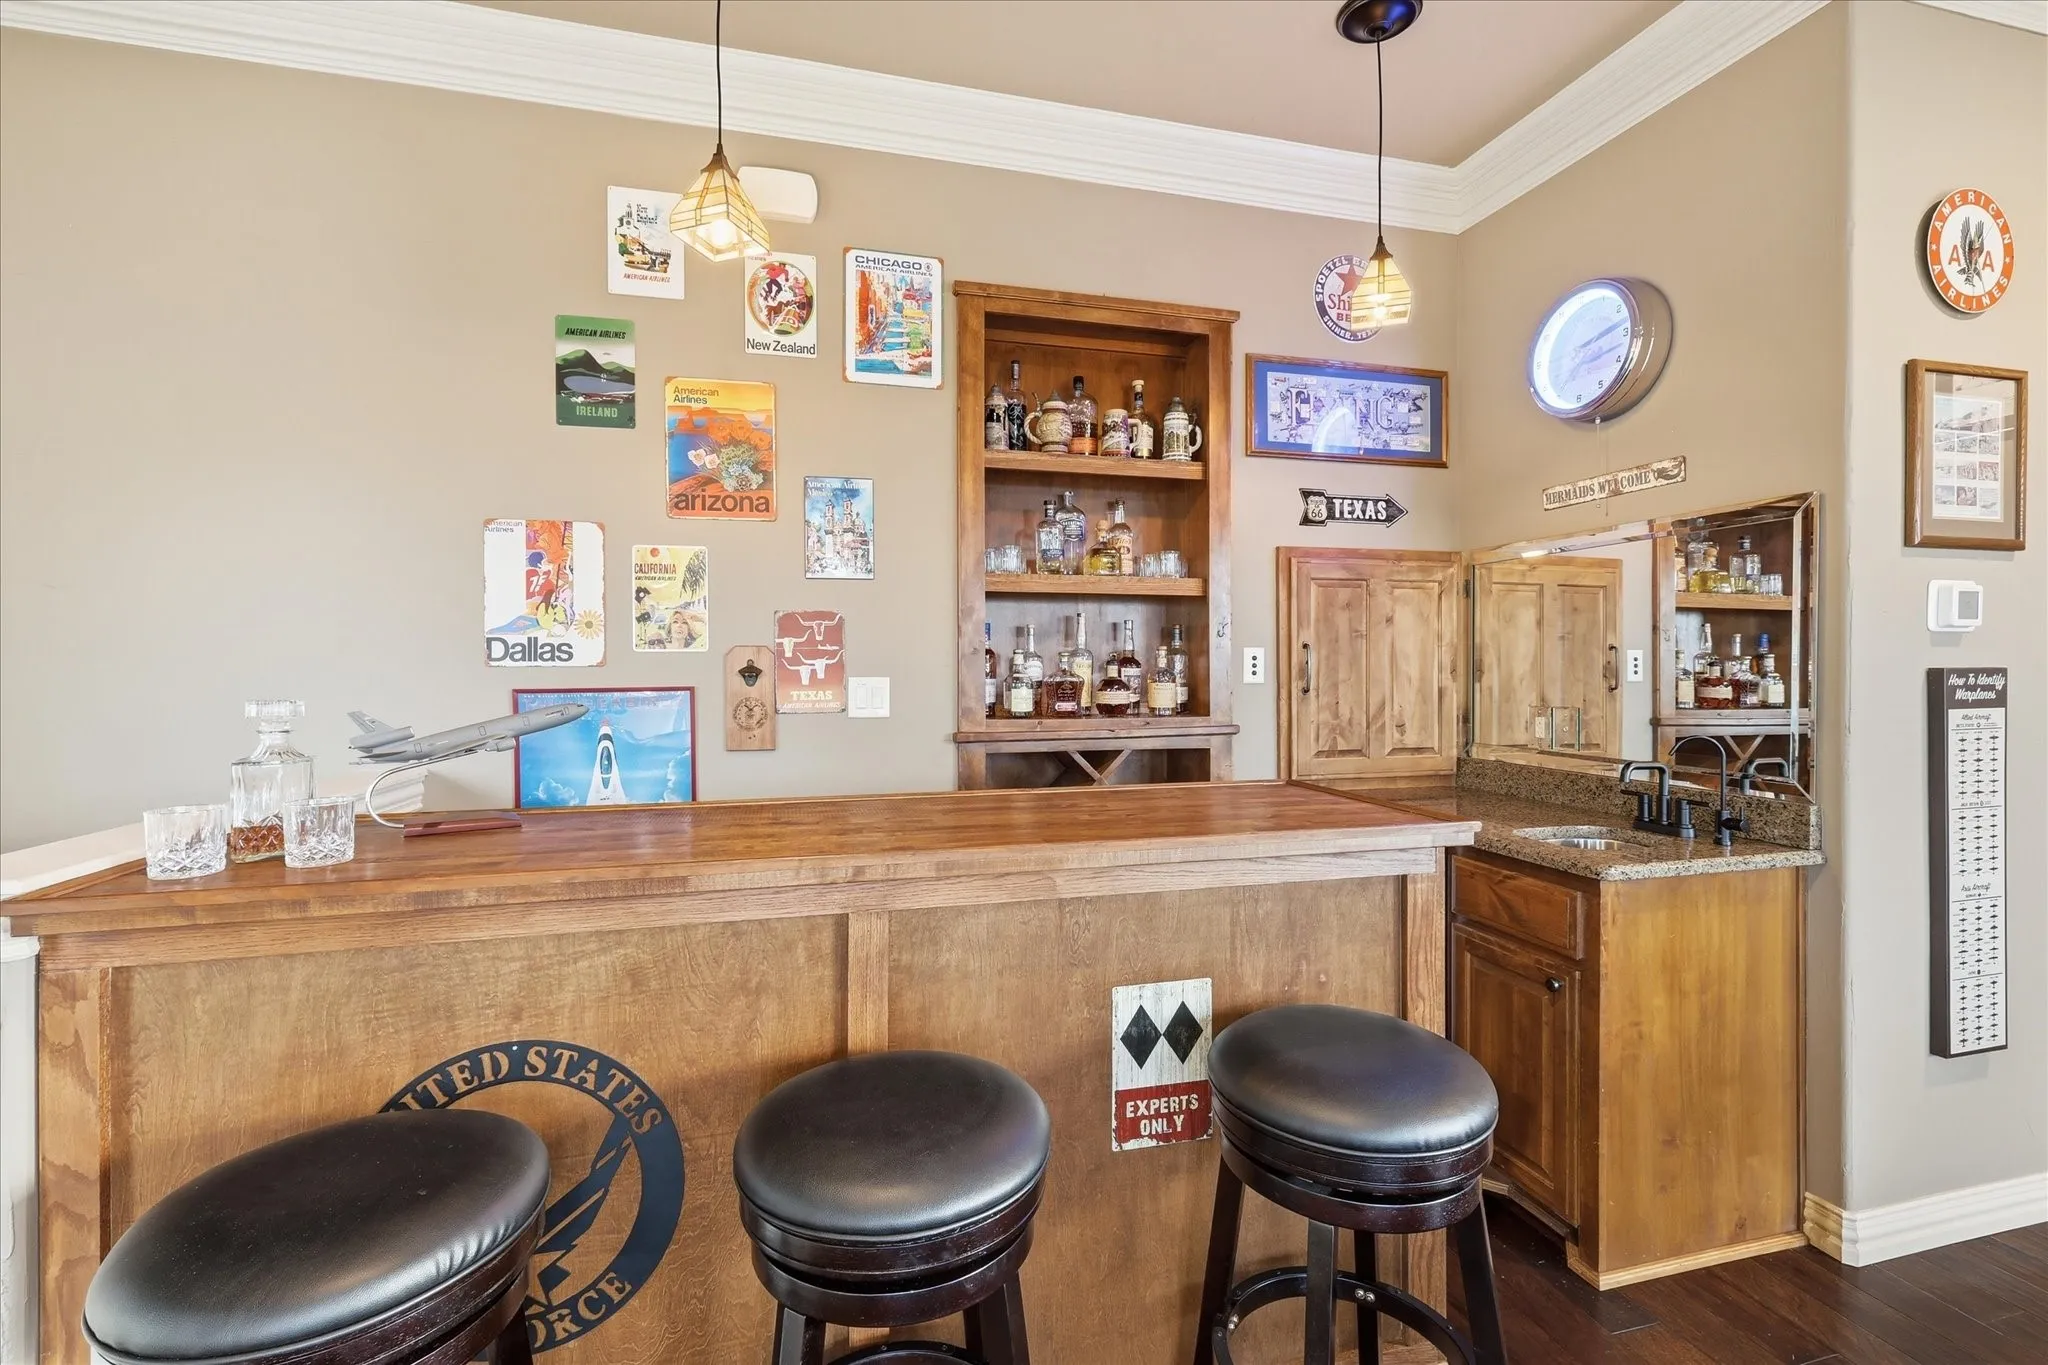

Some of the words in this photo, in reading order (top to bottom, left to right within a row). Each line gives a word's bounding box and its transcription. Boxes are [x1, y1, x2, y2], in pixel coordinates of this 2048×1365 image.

[1934, 191, 2011, 244] AMERICAN
[855, 255, 922, 270] CHICAGO
[1948, 244, 1961, 267] A
[1982, 250, 1994, 272] A
[856, 264, 897, 273] AMERICAN
[900, 269, 933, 277] AIRLINES
[1315, 256, 1349, 302] SPOETZL
[1932, 264, 2008, 309] AIRLINES
[1327, 293, 1351, 311] Shi
[1336, 312, 1351, 322] BE
[565, 327, 598, 337] AMERICAN
[599, 330, 626, 339] AIRLINES
[1622, 327, 1629, 337] 3
[746, 338, 772, 351] New
[773, 340, 816, 355] Zealand
[1615, 355, 1622, 363] 4
[673, 386, 719, 397] American
[1598, 380, 1604, 389] 5
[673, 394, 708, 404] Airlines
[576, 405, 618, 418] IRELAND
[674, 488, 770, 513] arizona
[1544, 483, 1595, 506] MERMAIDS
[1311, 508, 1323, 518] 66
[1332, 498, 1387, 520] TEXAS
[634, 563, 677, 574] CALIFORNIA
[486, 636, 574, 663] Dallas
[1948, 673, 1966, 686] How
[1967, 673, 1976, 685] To
[1976, 673, 2006, 690] Identify
[790, 690, 833, 701] TEXAS
[1955, 688, 1997, 703] Warplanes
[389, 1050, 510, 1111] ITED
[523, 1045, 663, 1134] STATES
[1126, 1093, 1199, 1118] EXPERTS
[1140, 1114, 1185, 1136] ONLY
[526, 1271, 633, 1348] ORCE
